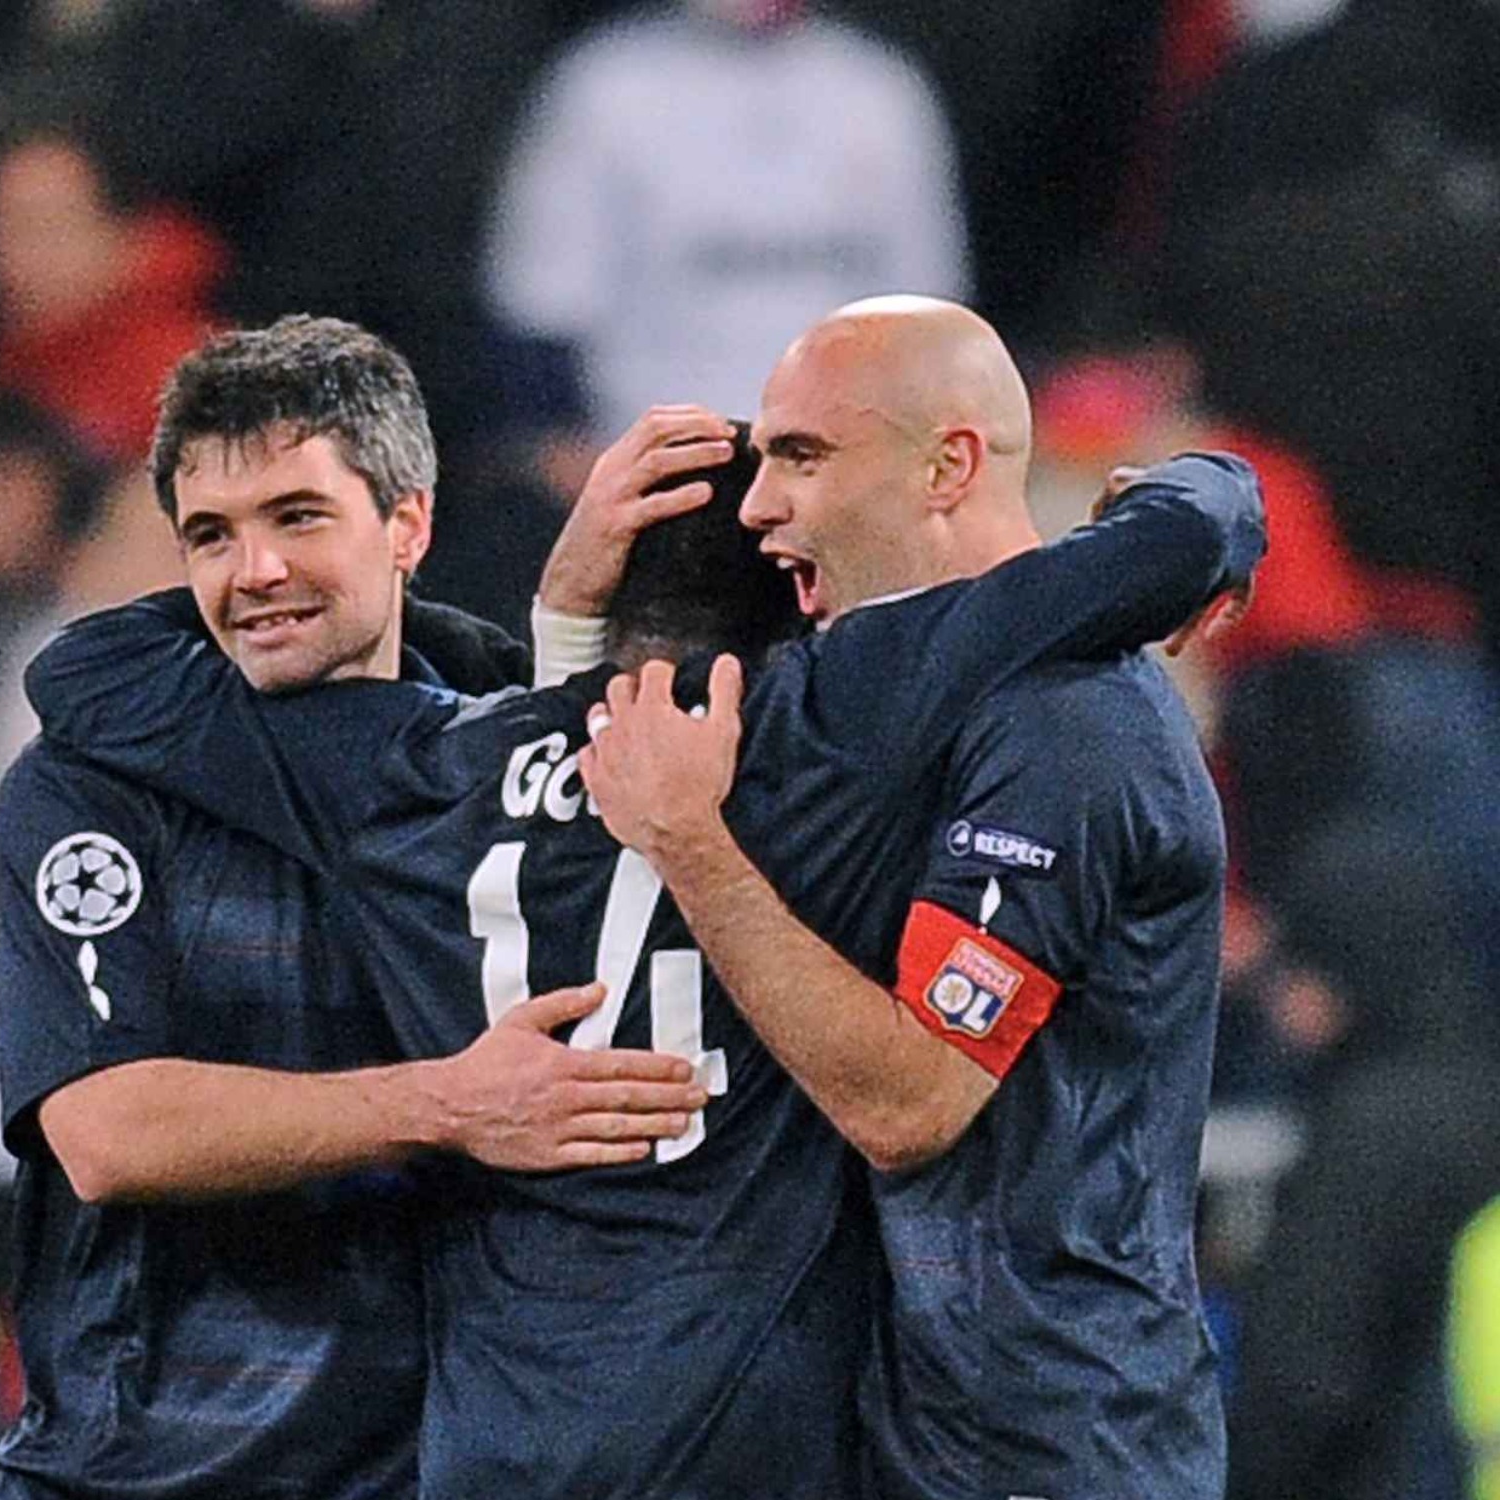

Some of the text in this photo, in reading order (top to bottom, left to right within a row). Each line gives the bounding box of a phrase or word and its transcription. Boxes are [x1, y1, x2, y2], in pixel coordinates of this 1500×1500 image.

[502, 731, 600, 821] Go
[975, 831, 1056, 869] RESPECT
[467, 841, 728, 1164] 14
[932, 972, 994, 1031] OL
